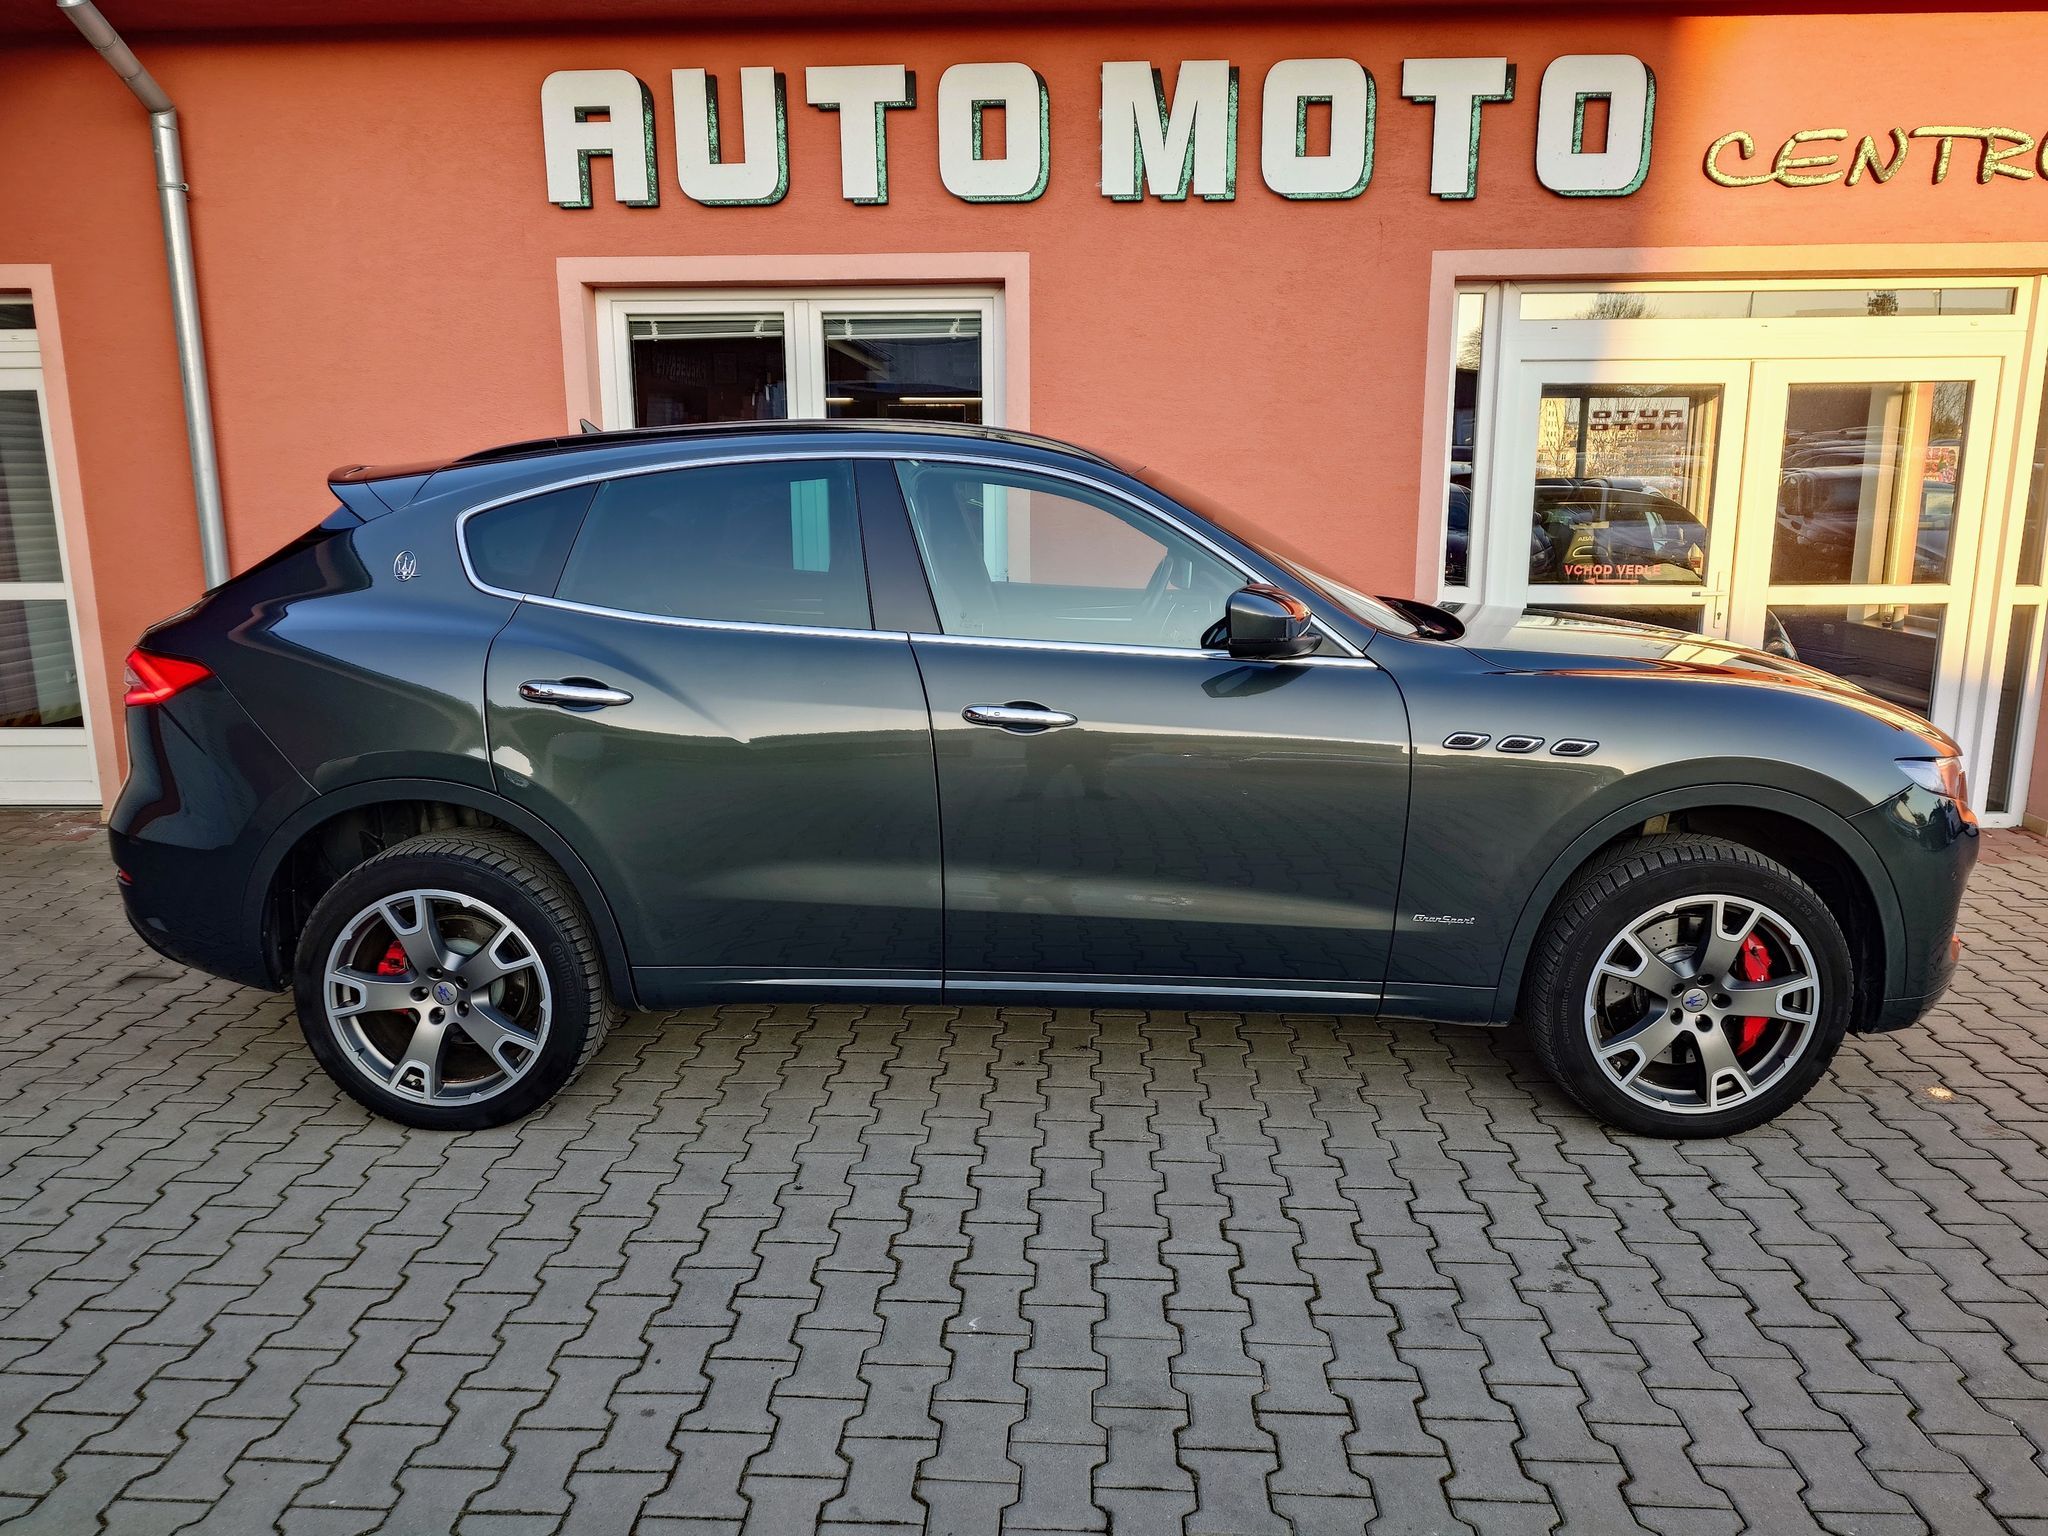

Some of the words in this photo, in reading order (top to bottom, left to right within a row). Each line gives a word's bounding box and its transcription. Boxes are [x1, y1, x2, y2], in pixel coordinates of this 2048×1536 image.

[541, 61, 1049, 208] AUTO
[1100, 53, 1656, 201] MOTO
[1703, 126, 2048, 188] CENTR
[1564, 564, 1613, 576] VCHOD
[1616, 564, 1662, 576] VEDLE
[1412, 914, 1475, 925] GranSport
